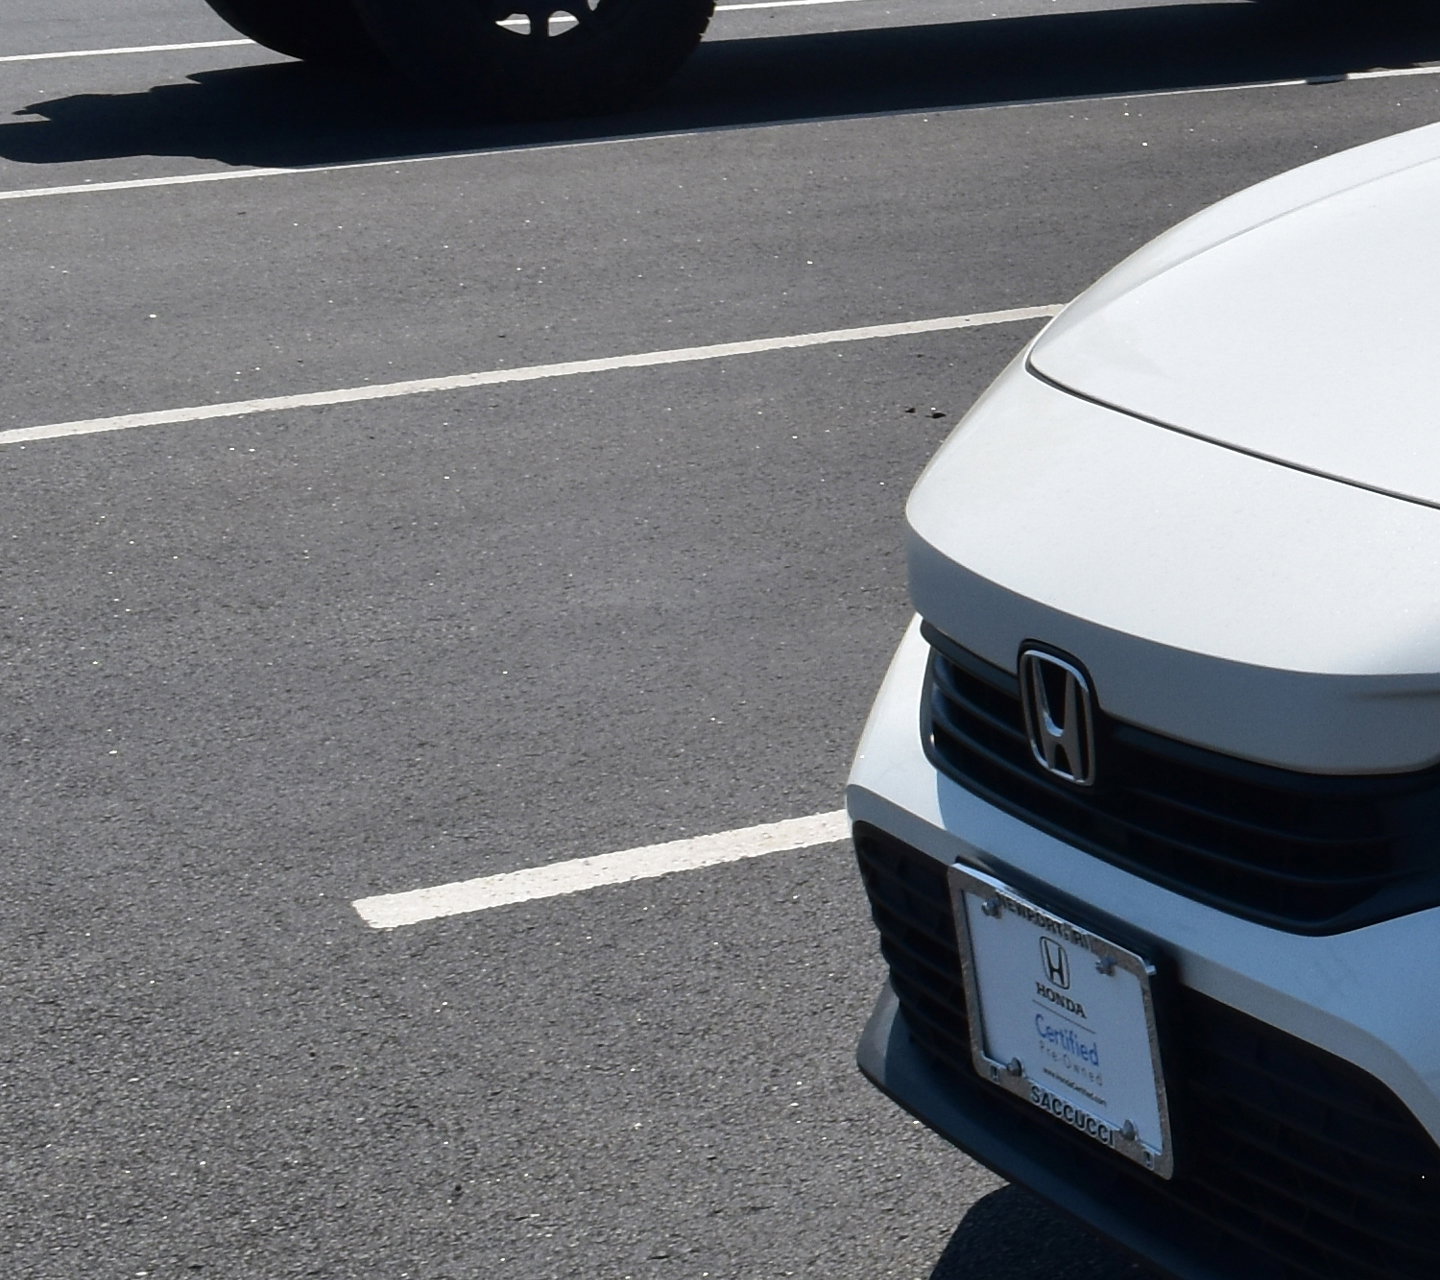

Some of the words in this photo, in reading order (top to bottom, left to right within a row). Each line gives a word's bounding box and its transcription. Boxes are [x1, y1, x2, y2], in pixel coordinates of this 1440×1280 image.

[1035, 981, 1087, 1019] HONDA
[1035, 1013, 1099, 1066] Certified
[1039, 1039, 1103, 1087] Pre-Owned
[1029, 1085, 1115, 1147] SACCUCCI
